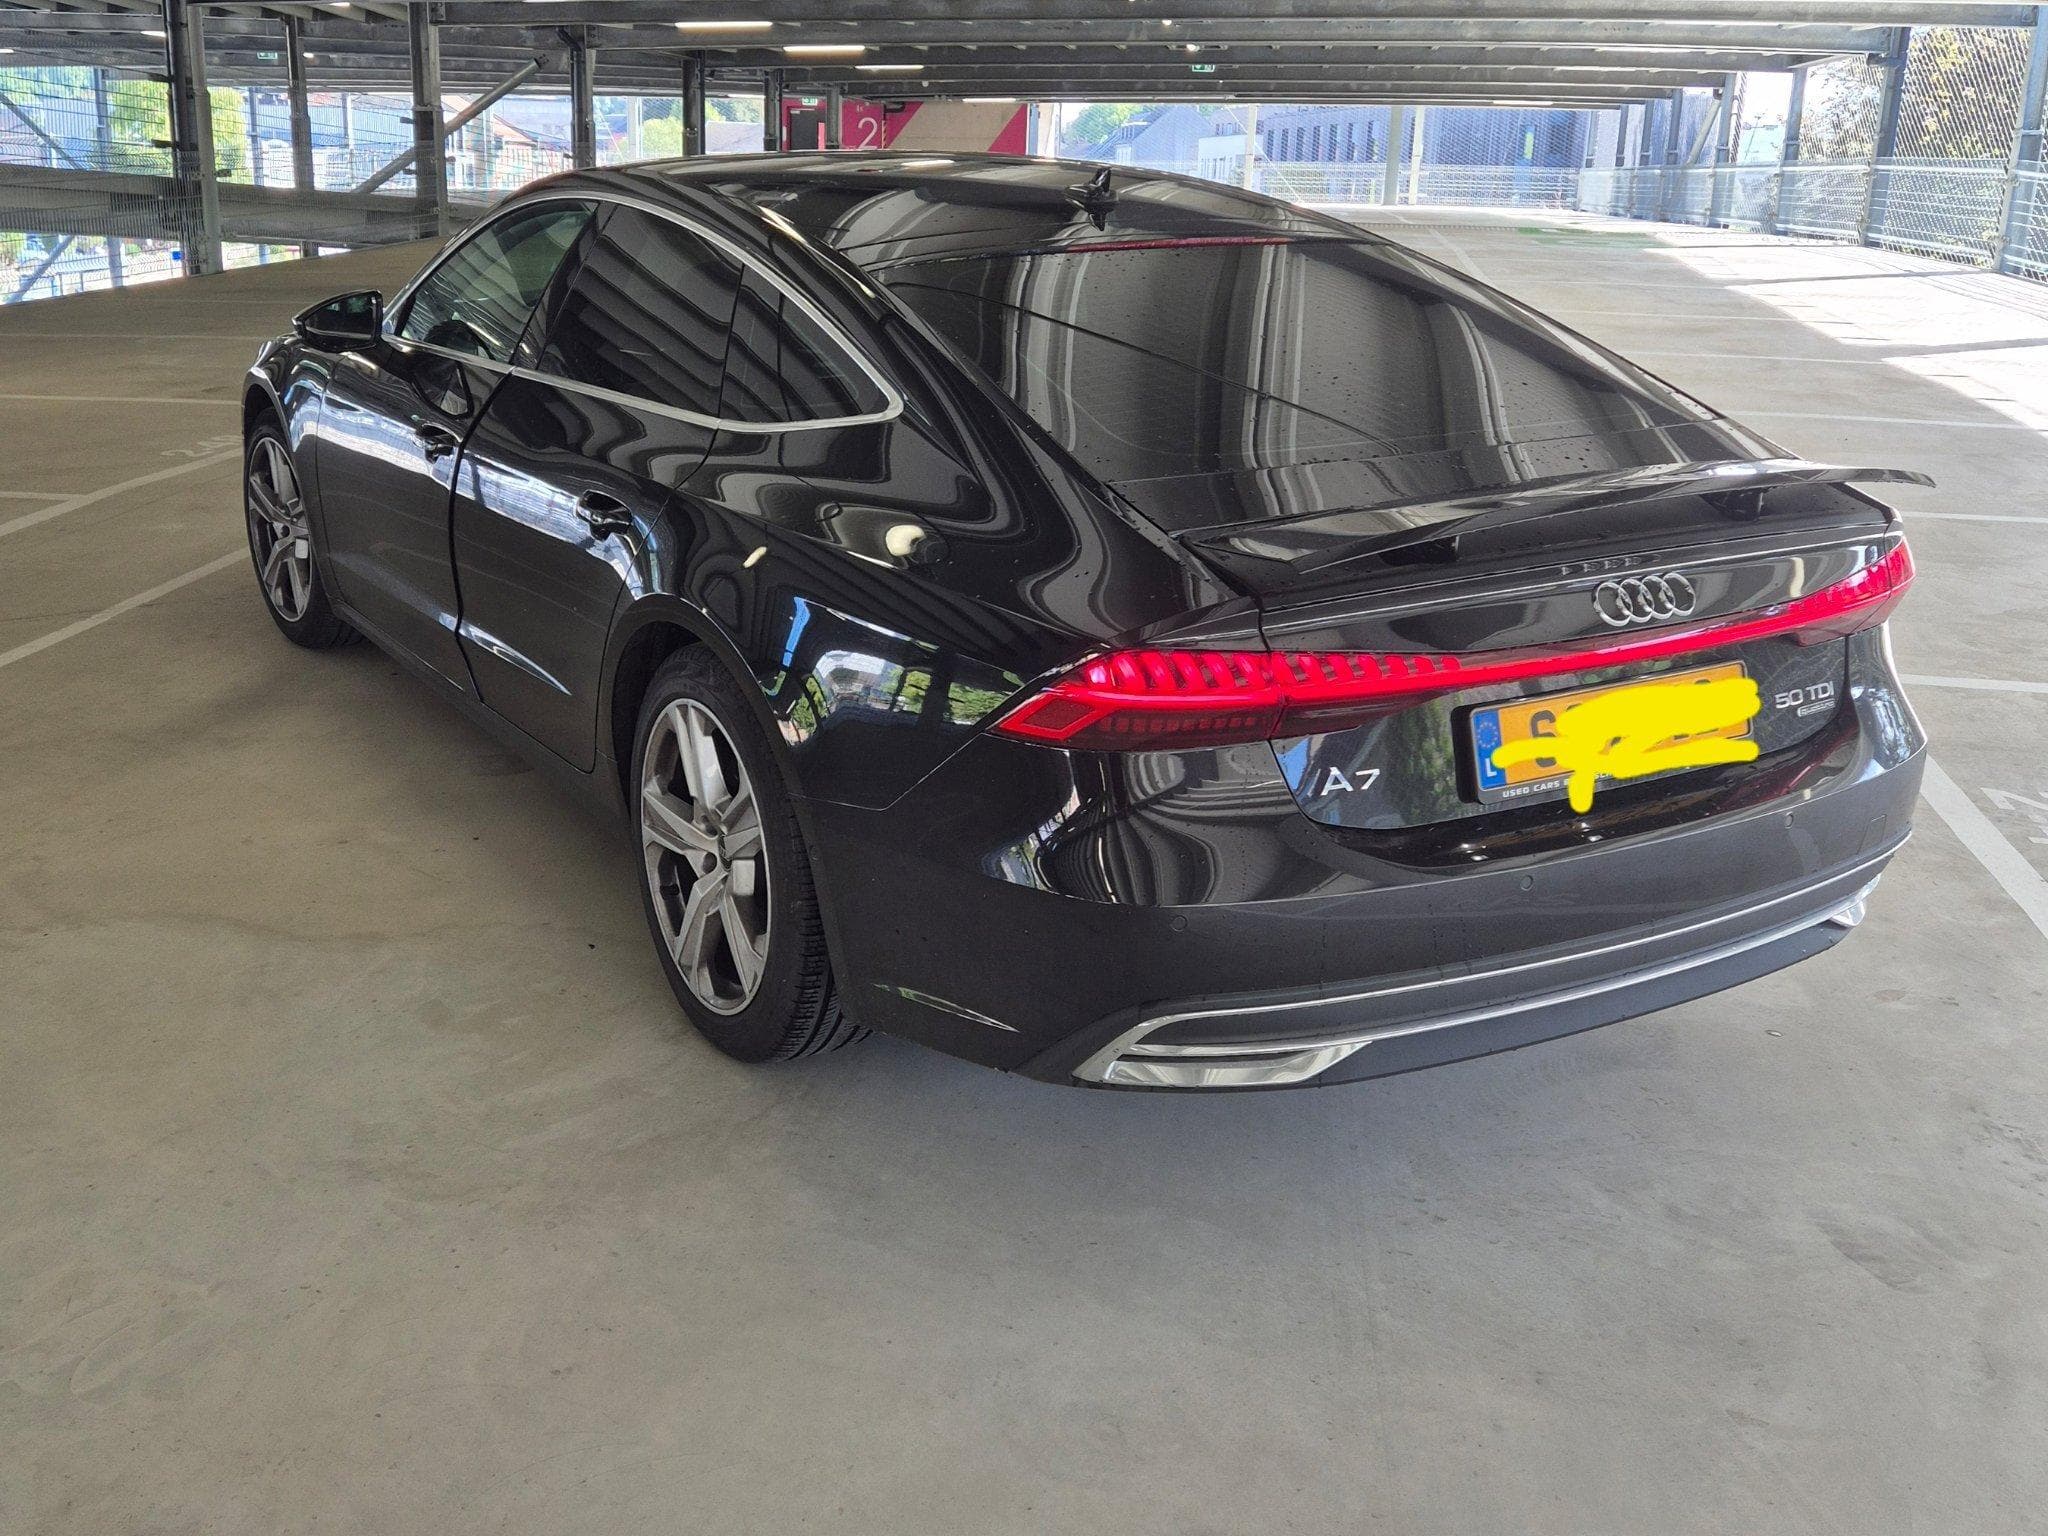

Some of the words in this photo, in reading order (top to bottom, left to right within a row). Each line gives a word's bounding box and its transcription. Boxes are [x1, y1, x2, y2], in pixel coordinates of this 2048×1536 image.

[857, 117, 878, 149] 2
[1774, 688, 1804, 709] 50
[1805, 680, 1835, 700] TDI
[1320, 766, 1381, 796] A7
[1502, 786, 1530, 798] USED
[1533, 780, 1560, 793] CARS
